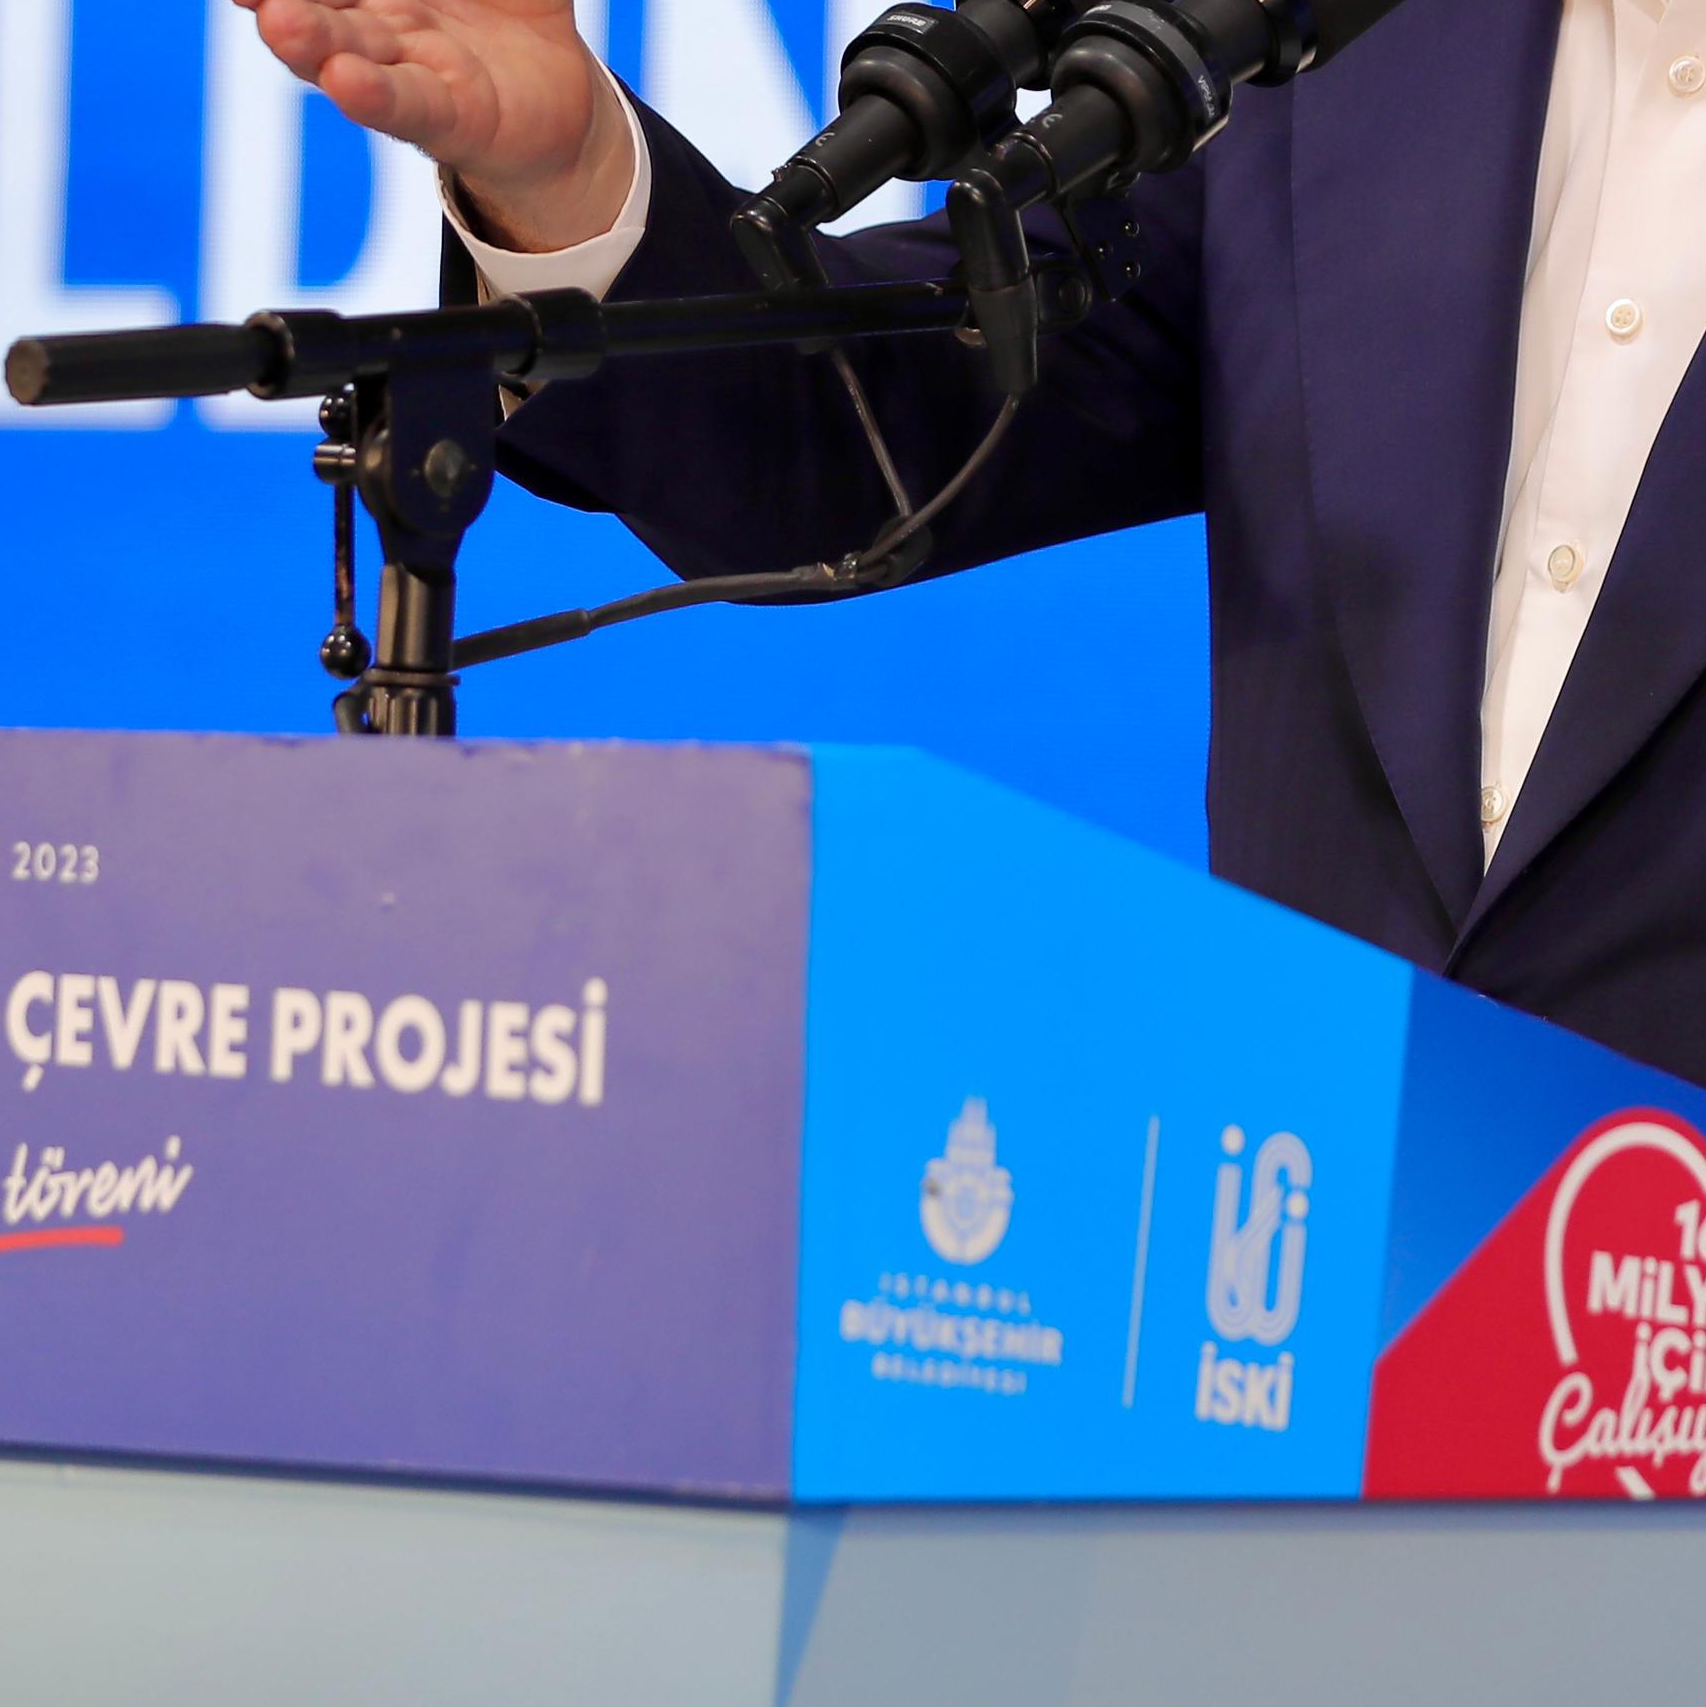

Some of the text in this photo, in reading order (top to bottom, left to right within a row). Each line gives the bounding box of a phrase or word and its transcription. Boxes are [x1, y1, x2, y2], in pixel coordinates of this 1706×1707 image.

[12, 841, 100, 885] 2023
[4, 969, 250, 1091] ÇEVRE
[270, 978, 607, 1106] PROJESİ
[2, 1134, 194, 1226] töreni
